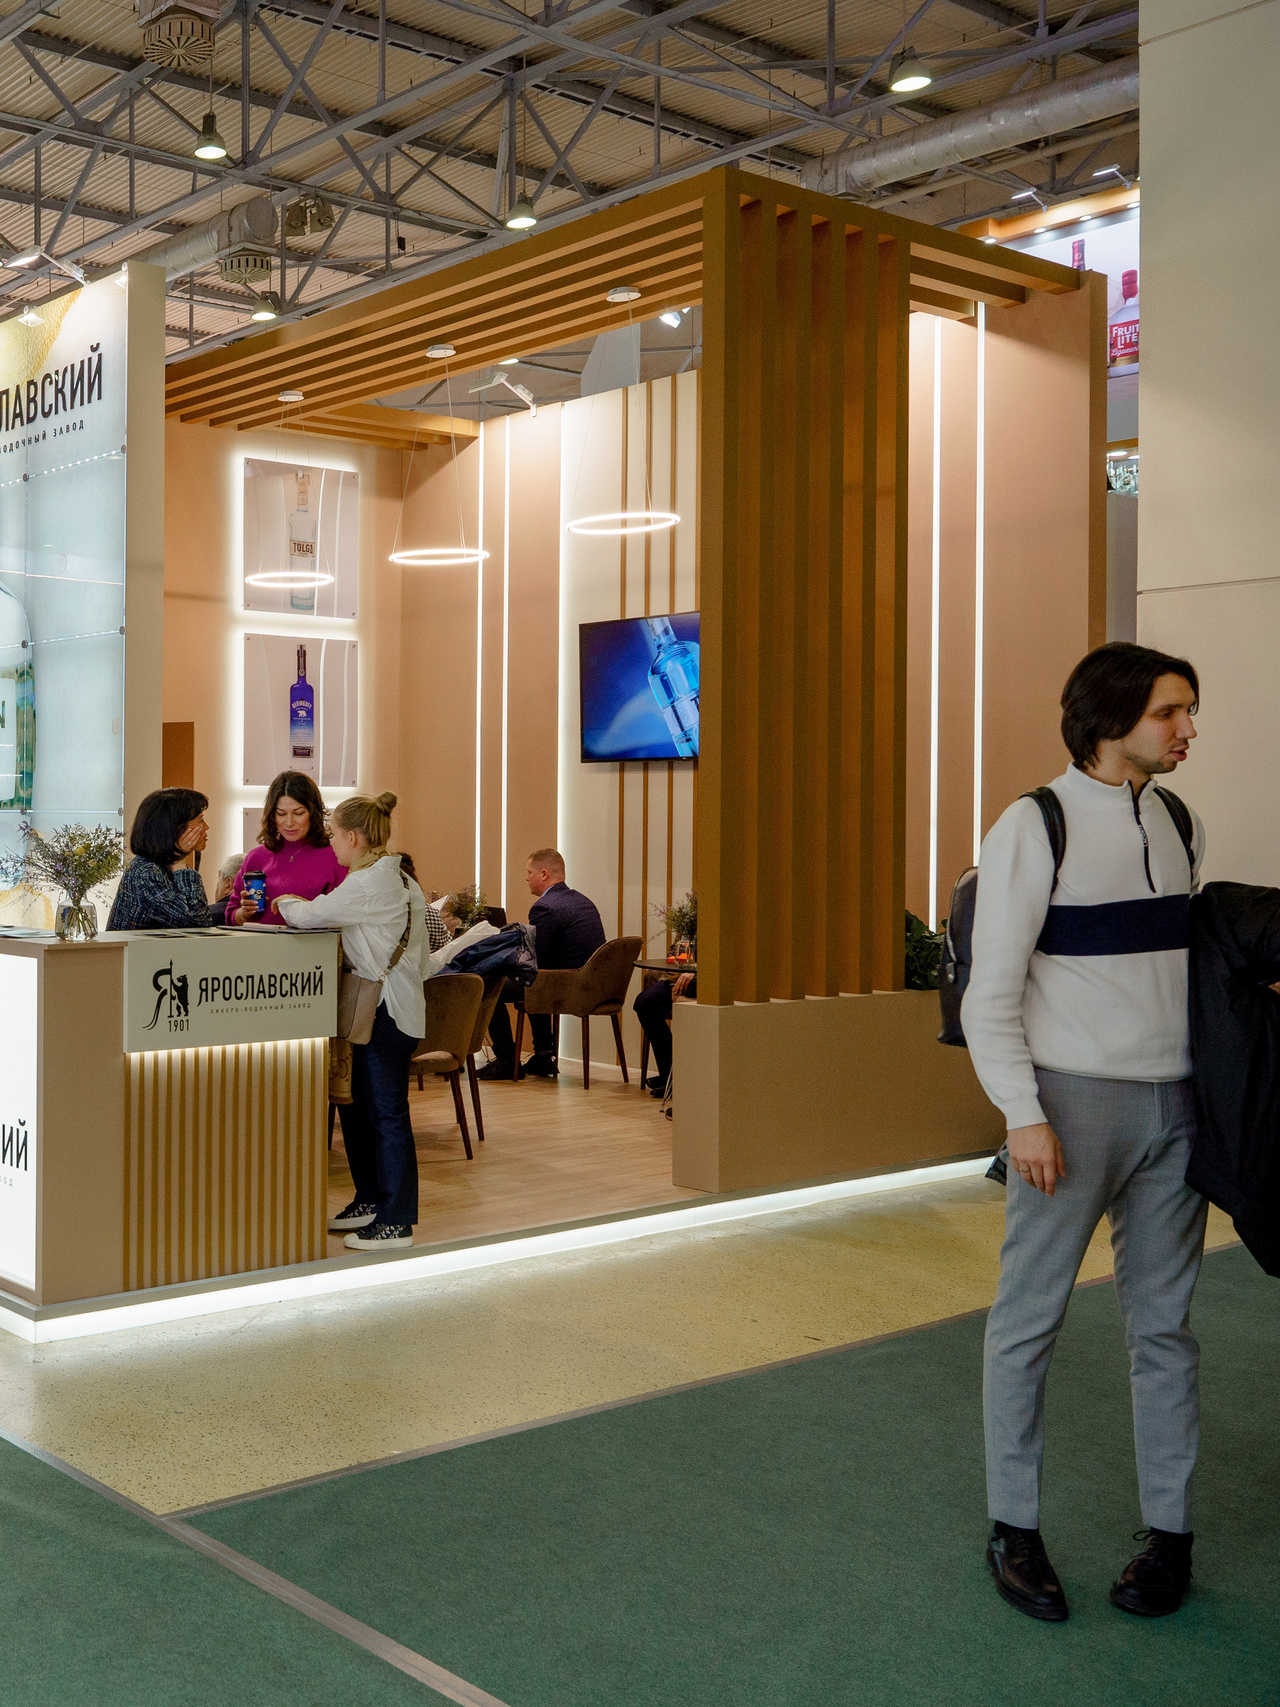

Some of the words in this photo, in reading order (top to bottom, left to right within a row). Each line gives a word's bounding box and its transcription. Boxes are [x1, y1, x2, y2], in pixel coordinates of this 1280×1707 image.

[1112, 324, 1140, 337] FRUIT
[1117, 333, 1138, 349] LITE
[53, 419, 85, 437] ЗАВОД
[197, 965, 324, 1007] ЯРОСЛАВСКИЙ
[210, 1003, 285, 1014] ЛИКЕРО-ВОДОЧНЫЙ
[288, 1002, 312, 1010] ЗАВОД
[168, 1019, 190, 1032] 1901
